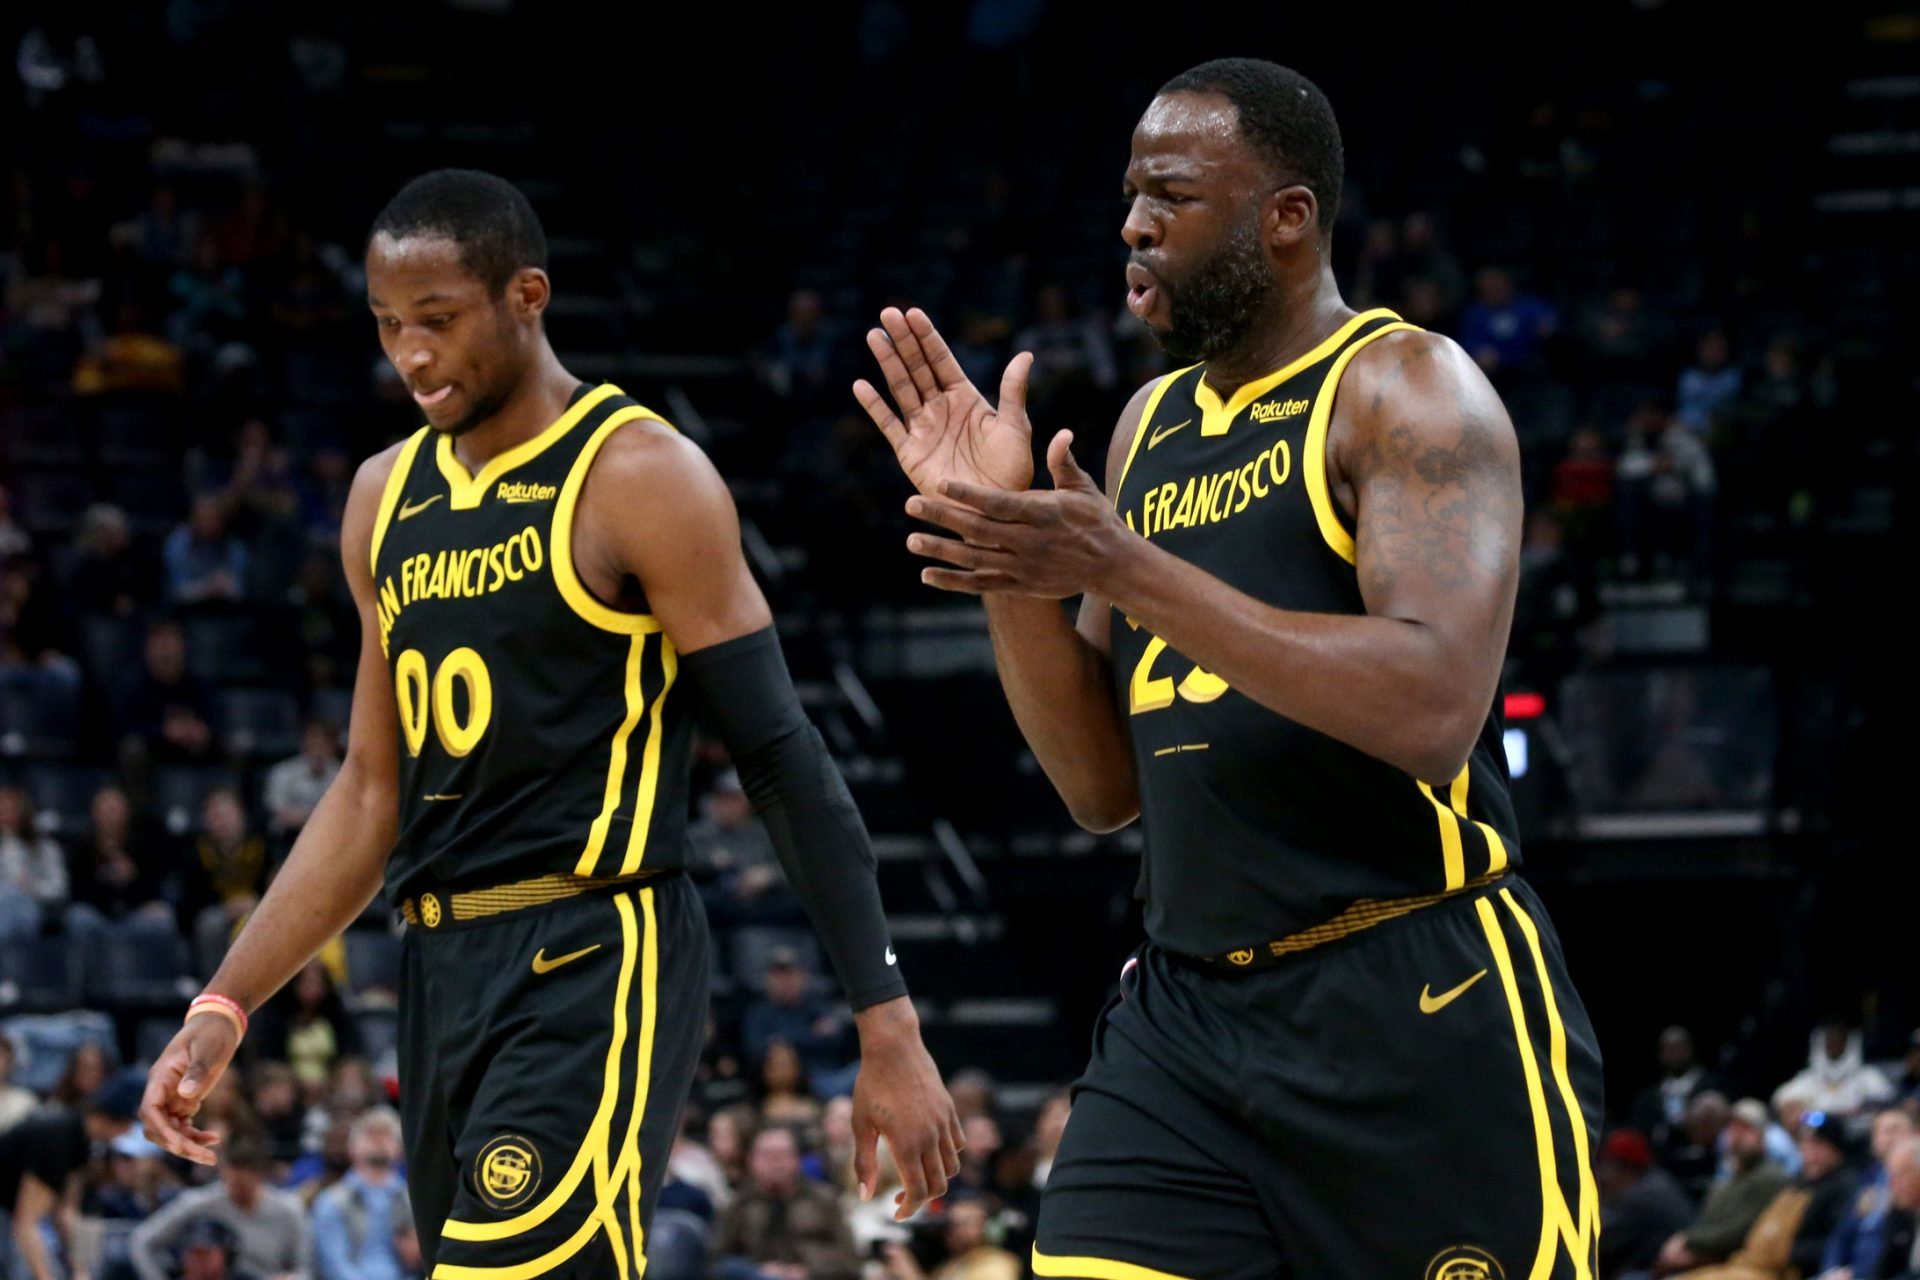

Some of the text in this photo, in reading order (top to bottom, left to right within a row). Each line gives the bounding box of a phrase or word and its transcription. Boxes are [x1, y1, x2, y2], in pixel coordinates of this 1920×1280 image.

[1250, 399, 1309, 421] Rakuten
[496, 481, 557, 503] Rakuten
[1143, 439, 1291, 539] FRANCISCO
[401, 525, 544, 606] FRANCISCO
[395, 646, 493, 758] 00
